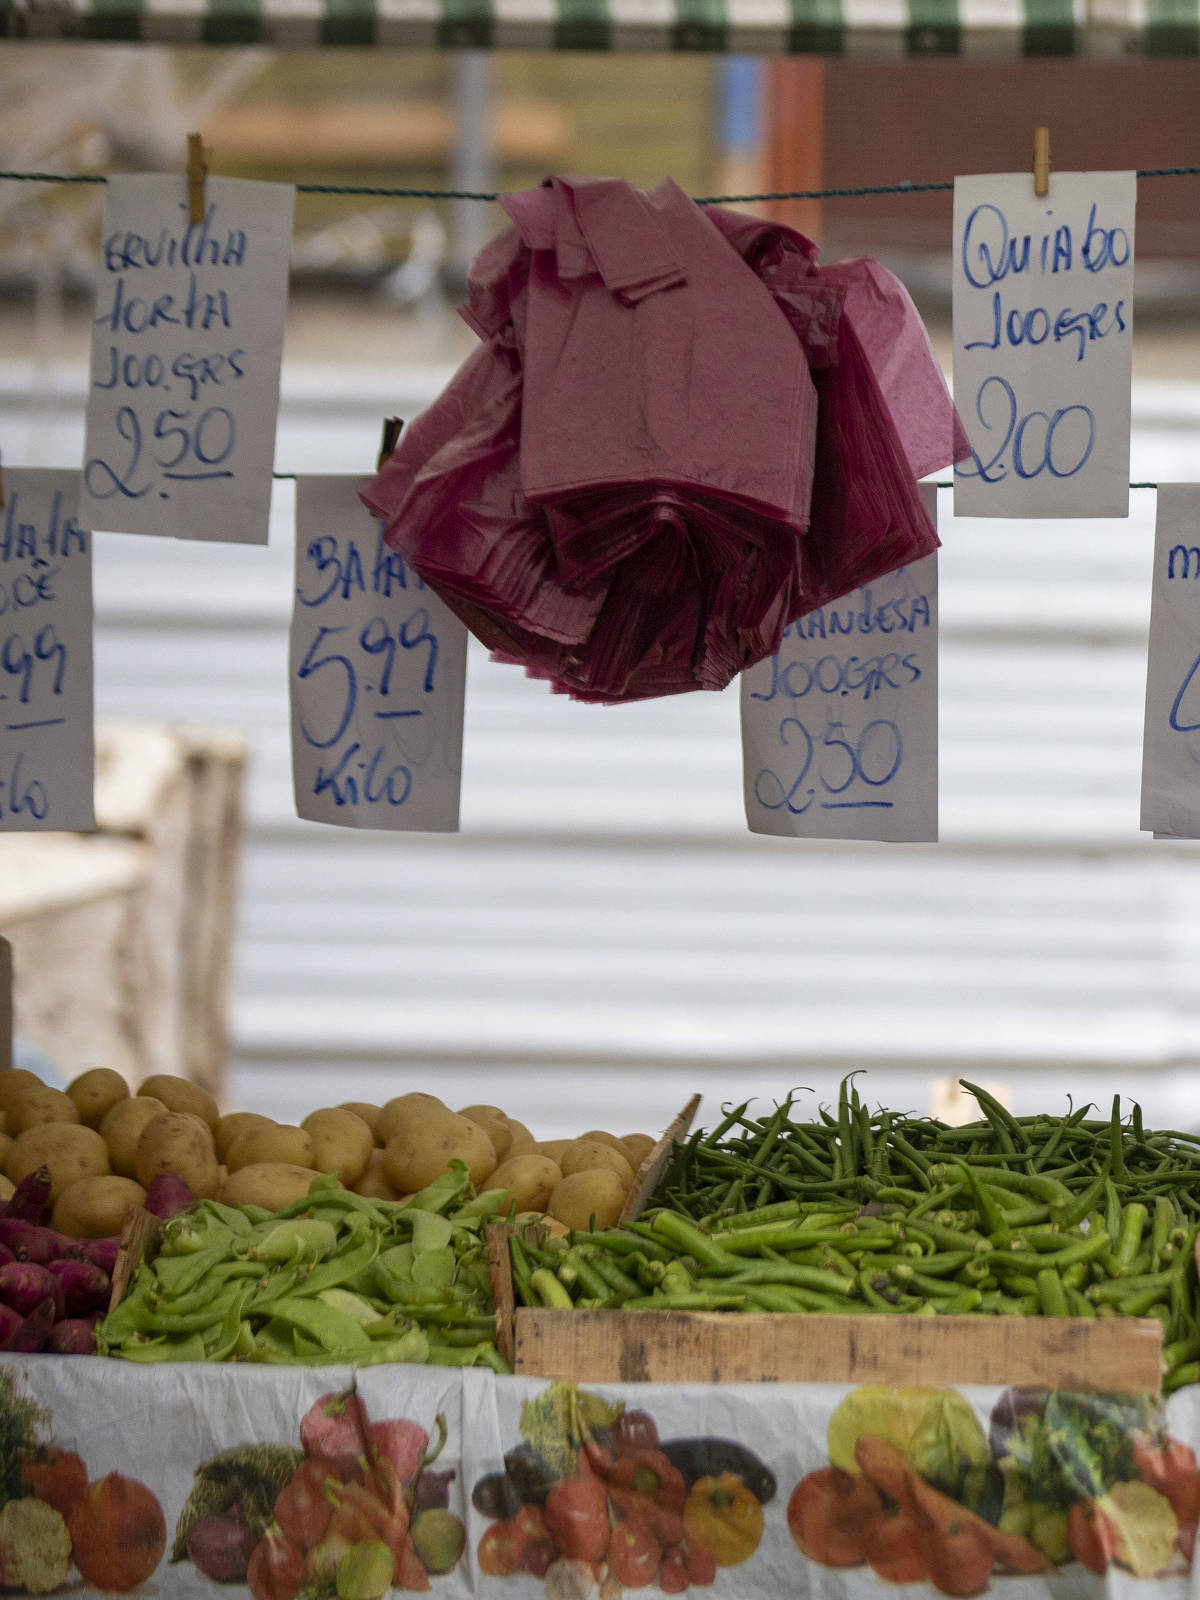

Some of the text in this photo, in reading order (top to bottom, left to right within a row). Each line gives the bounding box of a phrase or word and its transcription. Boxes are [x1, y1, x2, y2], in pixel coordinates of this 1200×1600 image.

[85, 407, 236, 499] 2.50
[298, 608, 438, 748] 5.99
[755, 718, 903, 814] 2.50
